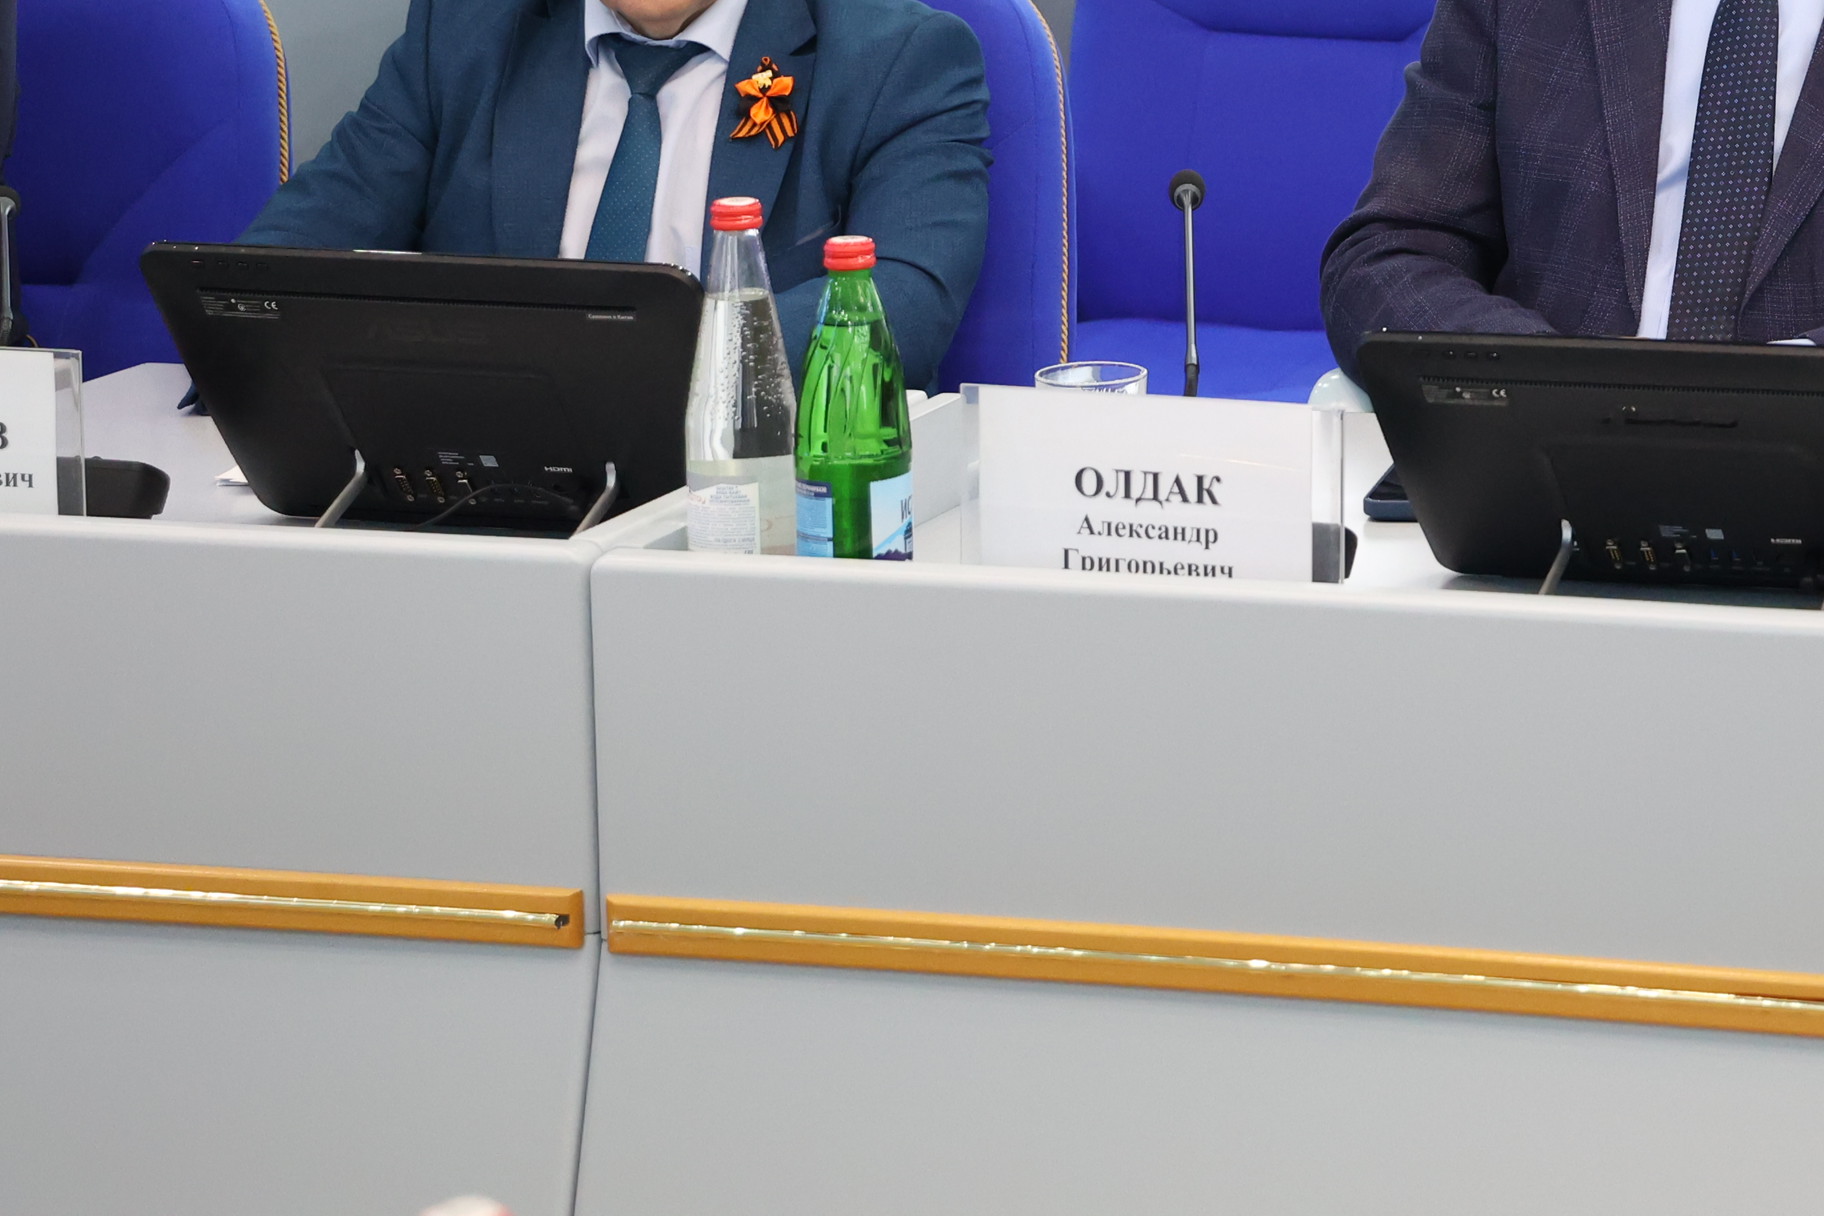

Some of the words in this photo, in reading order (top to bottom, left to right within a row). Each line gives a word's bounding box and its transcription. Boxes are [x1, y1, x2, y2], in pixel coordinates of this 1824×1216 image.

[1074, 466, 1223, 509] ОЛДАК
[1077, 514, 1219, 550] Александр
[1062, 547, 1234, 579] Григорьевич
